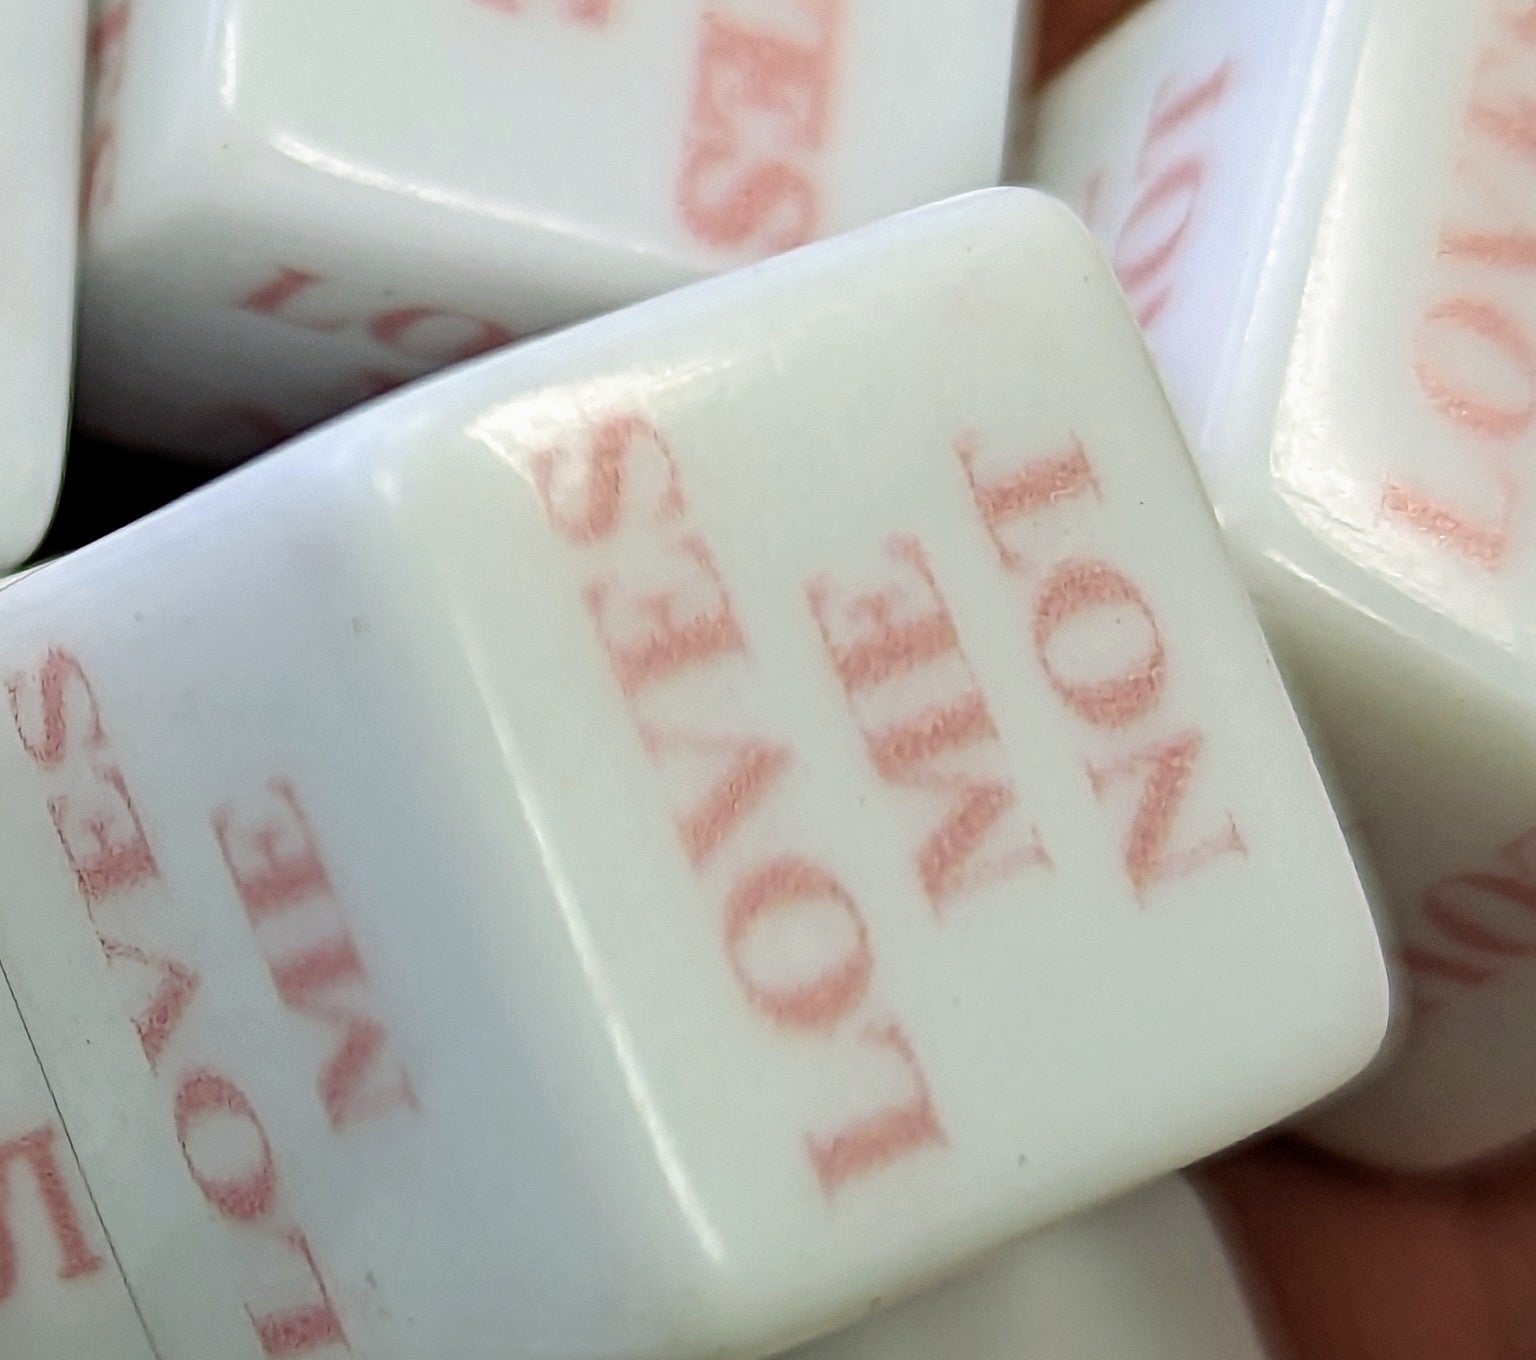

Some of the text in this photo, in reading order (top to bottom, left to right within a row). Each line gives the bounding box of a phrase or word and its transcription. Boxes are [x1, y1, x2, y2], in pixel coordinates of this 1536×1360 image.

[531, 411, 954, 1203] LOVES
[803, 533, 1057, 928] ME
[953, 427, 1251, 908] NOT
[208, 774, 425, 1137] ME
